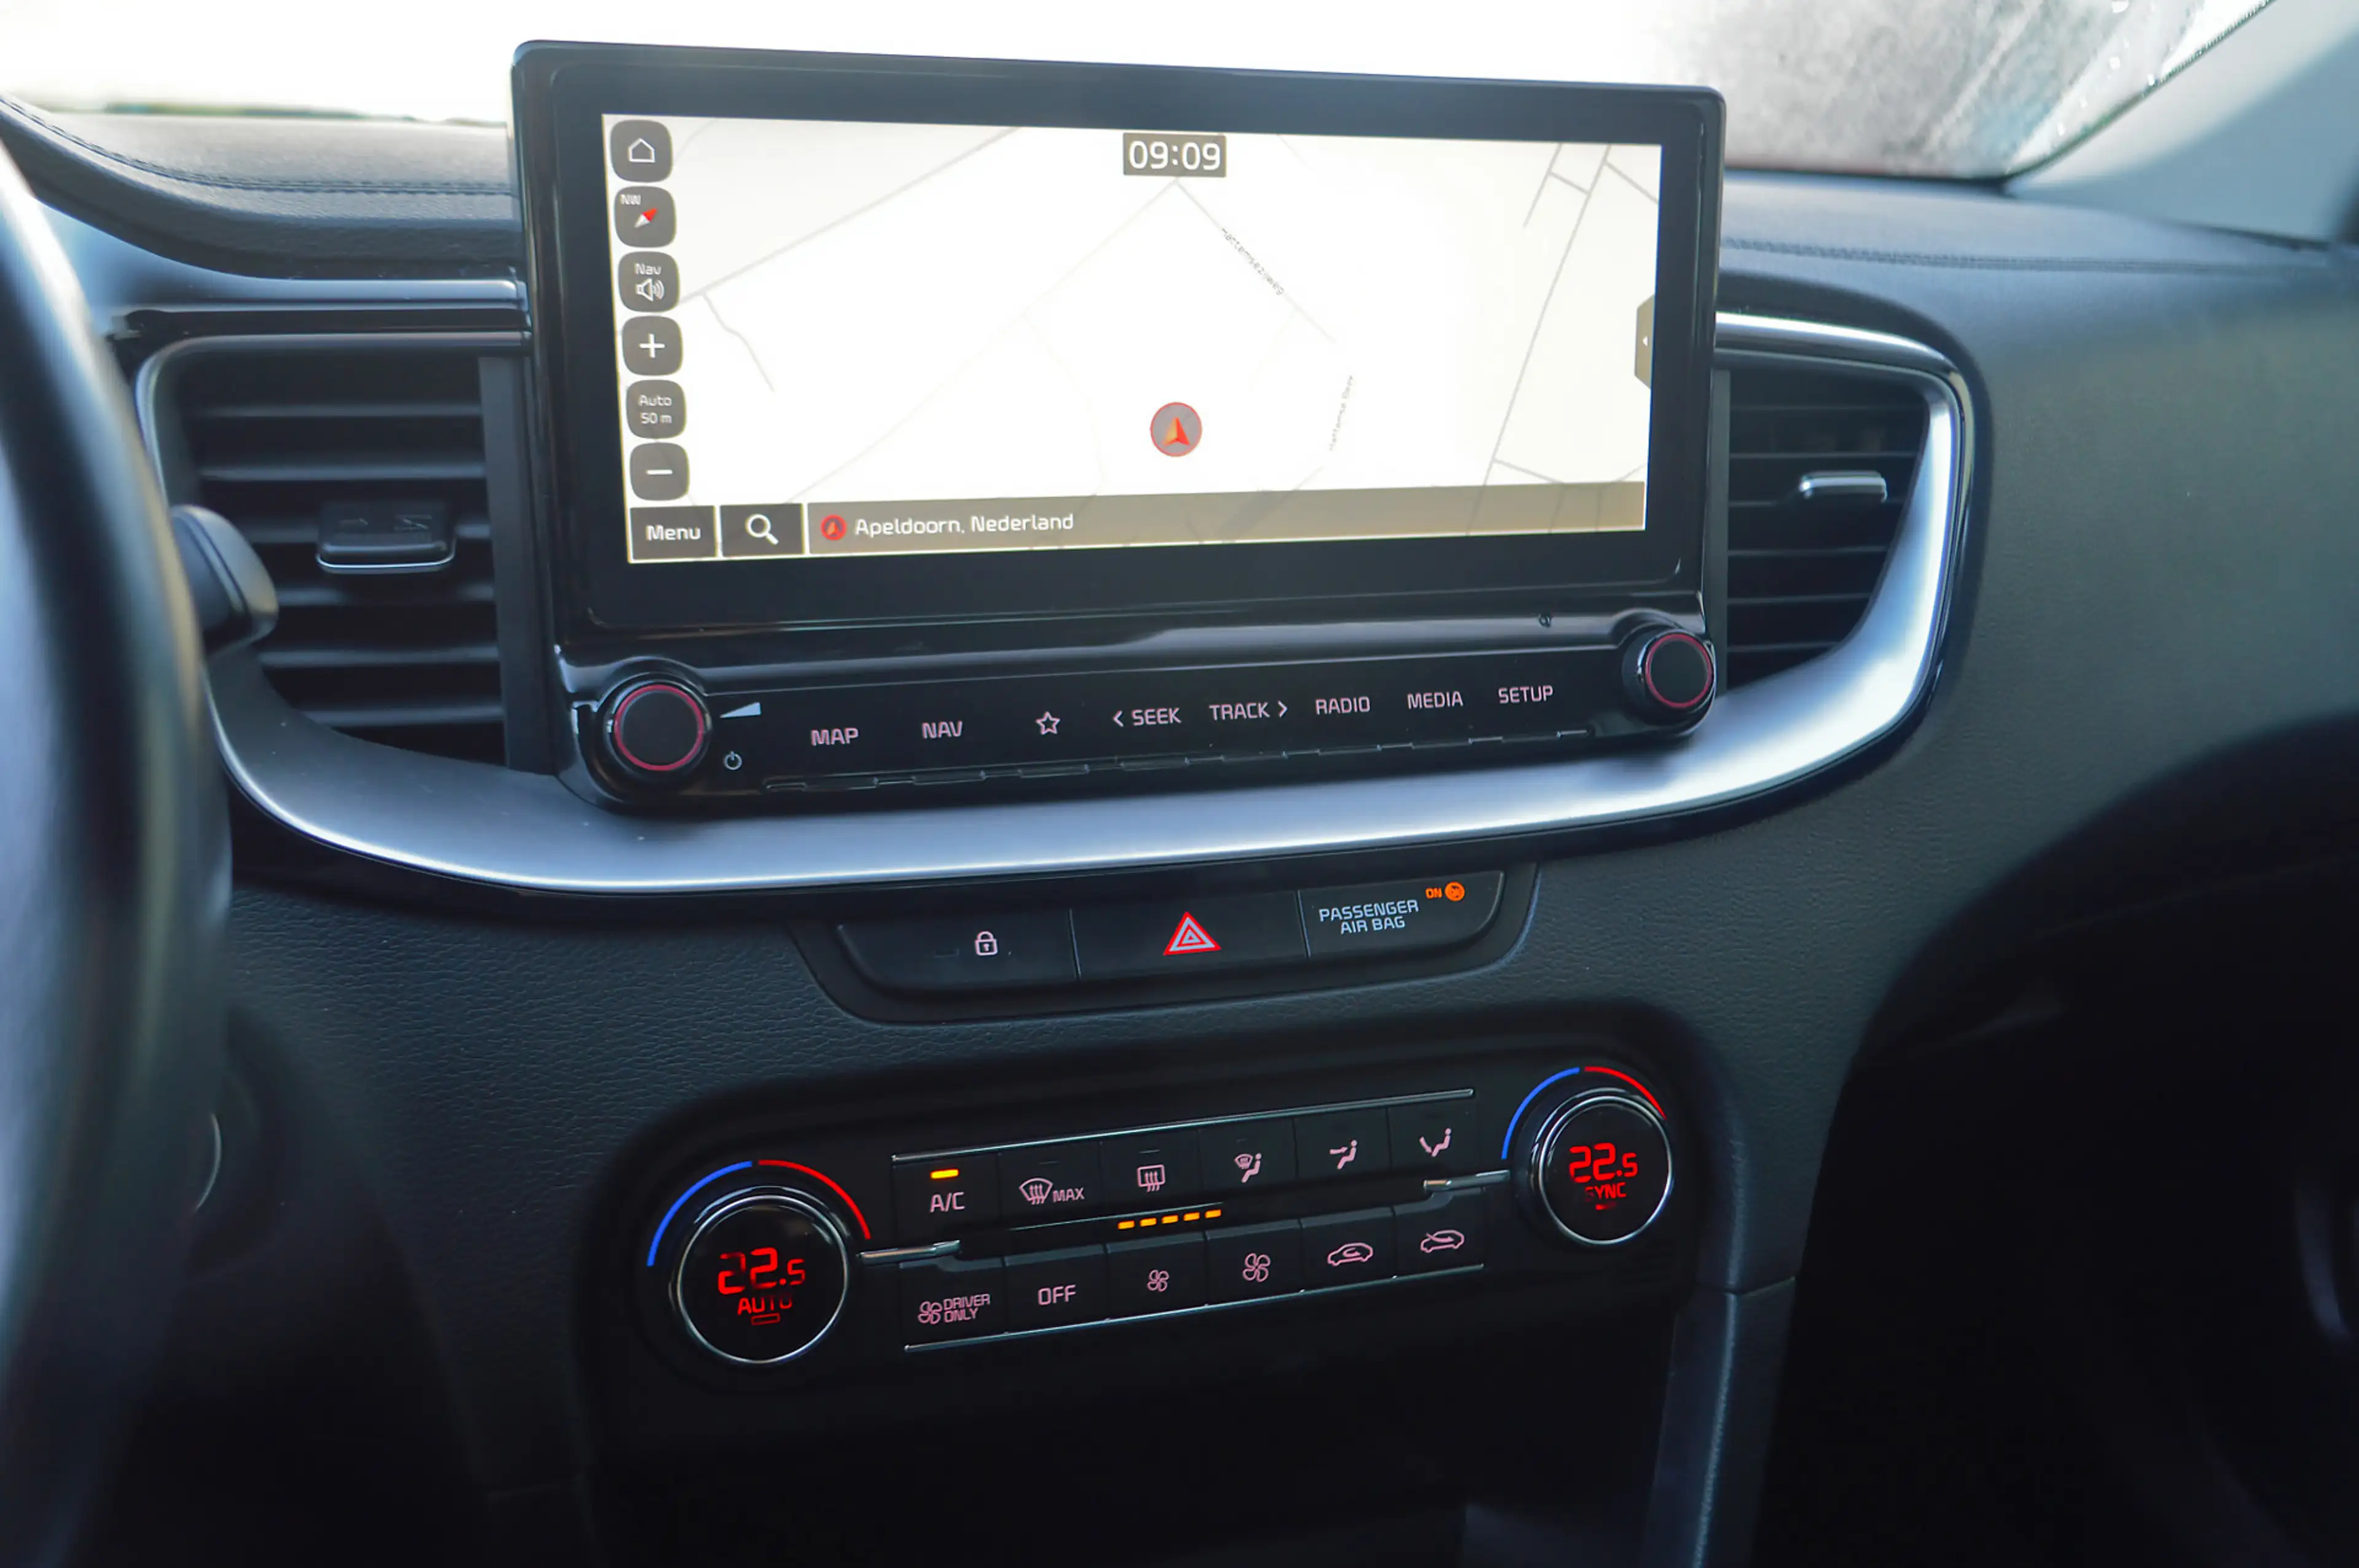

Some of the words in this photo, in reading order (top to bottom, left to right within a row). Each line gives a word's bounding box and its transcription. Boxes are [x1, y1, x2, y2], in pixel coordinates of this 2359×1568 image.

[1130, 141, 1220, 170] 09:09
[620, 194, 641, 205] NW
[636, 263, 660, 275] Nav
[640, 395, 671, 406] Auto
[642, 413, 657, 423] 50
[647, 525, 700, 540] Menu
[856, 518, 964, 537] Apeldoorn,
[972, 514, 1073, 531] Nederland
[1408, 692, 1463, 709] MEDIA
[1499, 685, 1553, 703] SETUP
[1210, 703, 1269, 720] TRACK
[1316, 697, 1370, 714] RADIO
[1132, 708, 1181, 725] SEEK
[812, 728, 858, 746] MAP
[923, 721, 962, 738] NAV
[1426, 887, 1442, 899] ON
[1319, 900, 1418, 922] PASSENGER
[1340, 920, 1368, 934] AIR
[1372, 916, 1406, 931] BAG
[1570, 1143, 1638, 1183] 22.5
[1053, 1188, 1084, 1202] MAX
[1585, 1182, 1626, 1201] SYNC
[931, 1192, 964, 1212] A/C
[718, 1247, 806, 1295] 22.5
[944, 1293, 990, 1310] DRIVER
[1038, 1285, 1076, 1305] OFF
[737, 1295, 792, 1316] AUTO
[944, 1307, 978, 1323] ONLY
